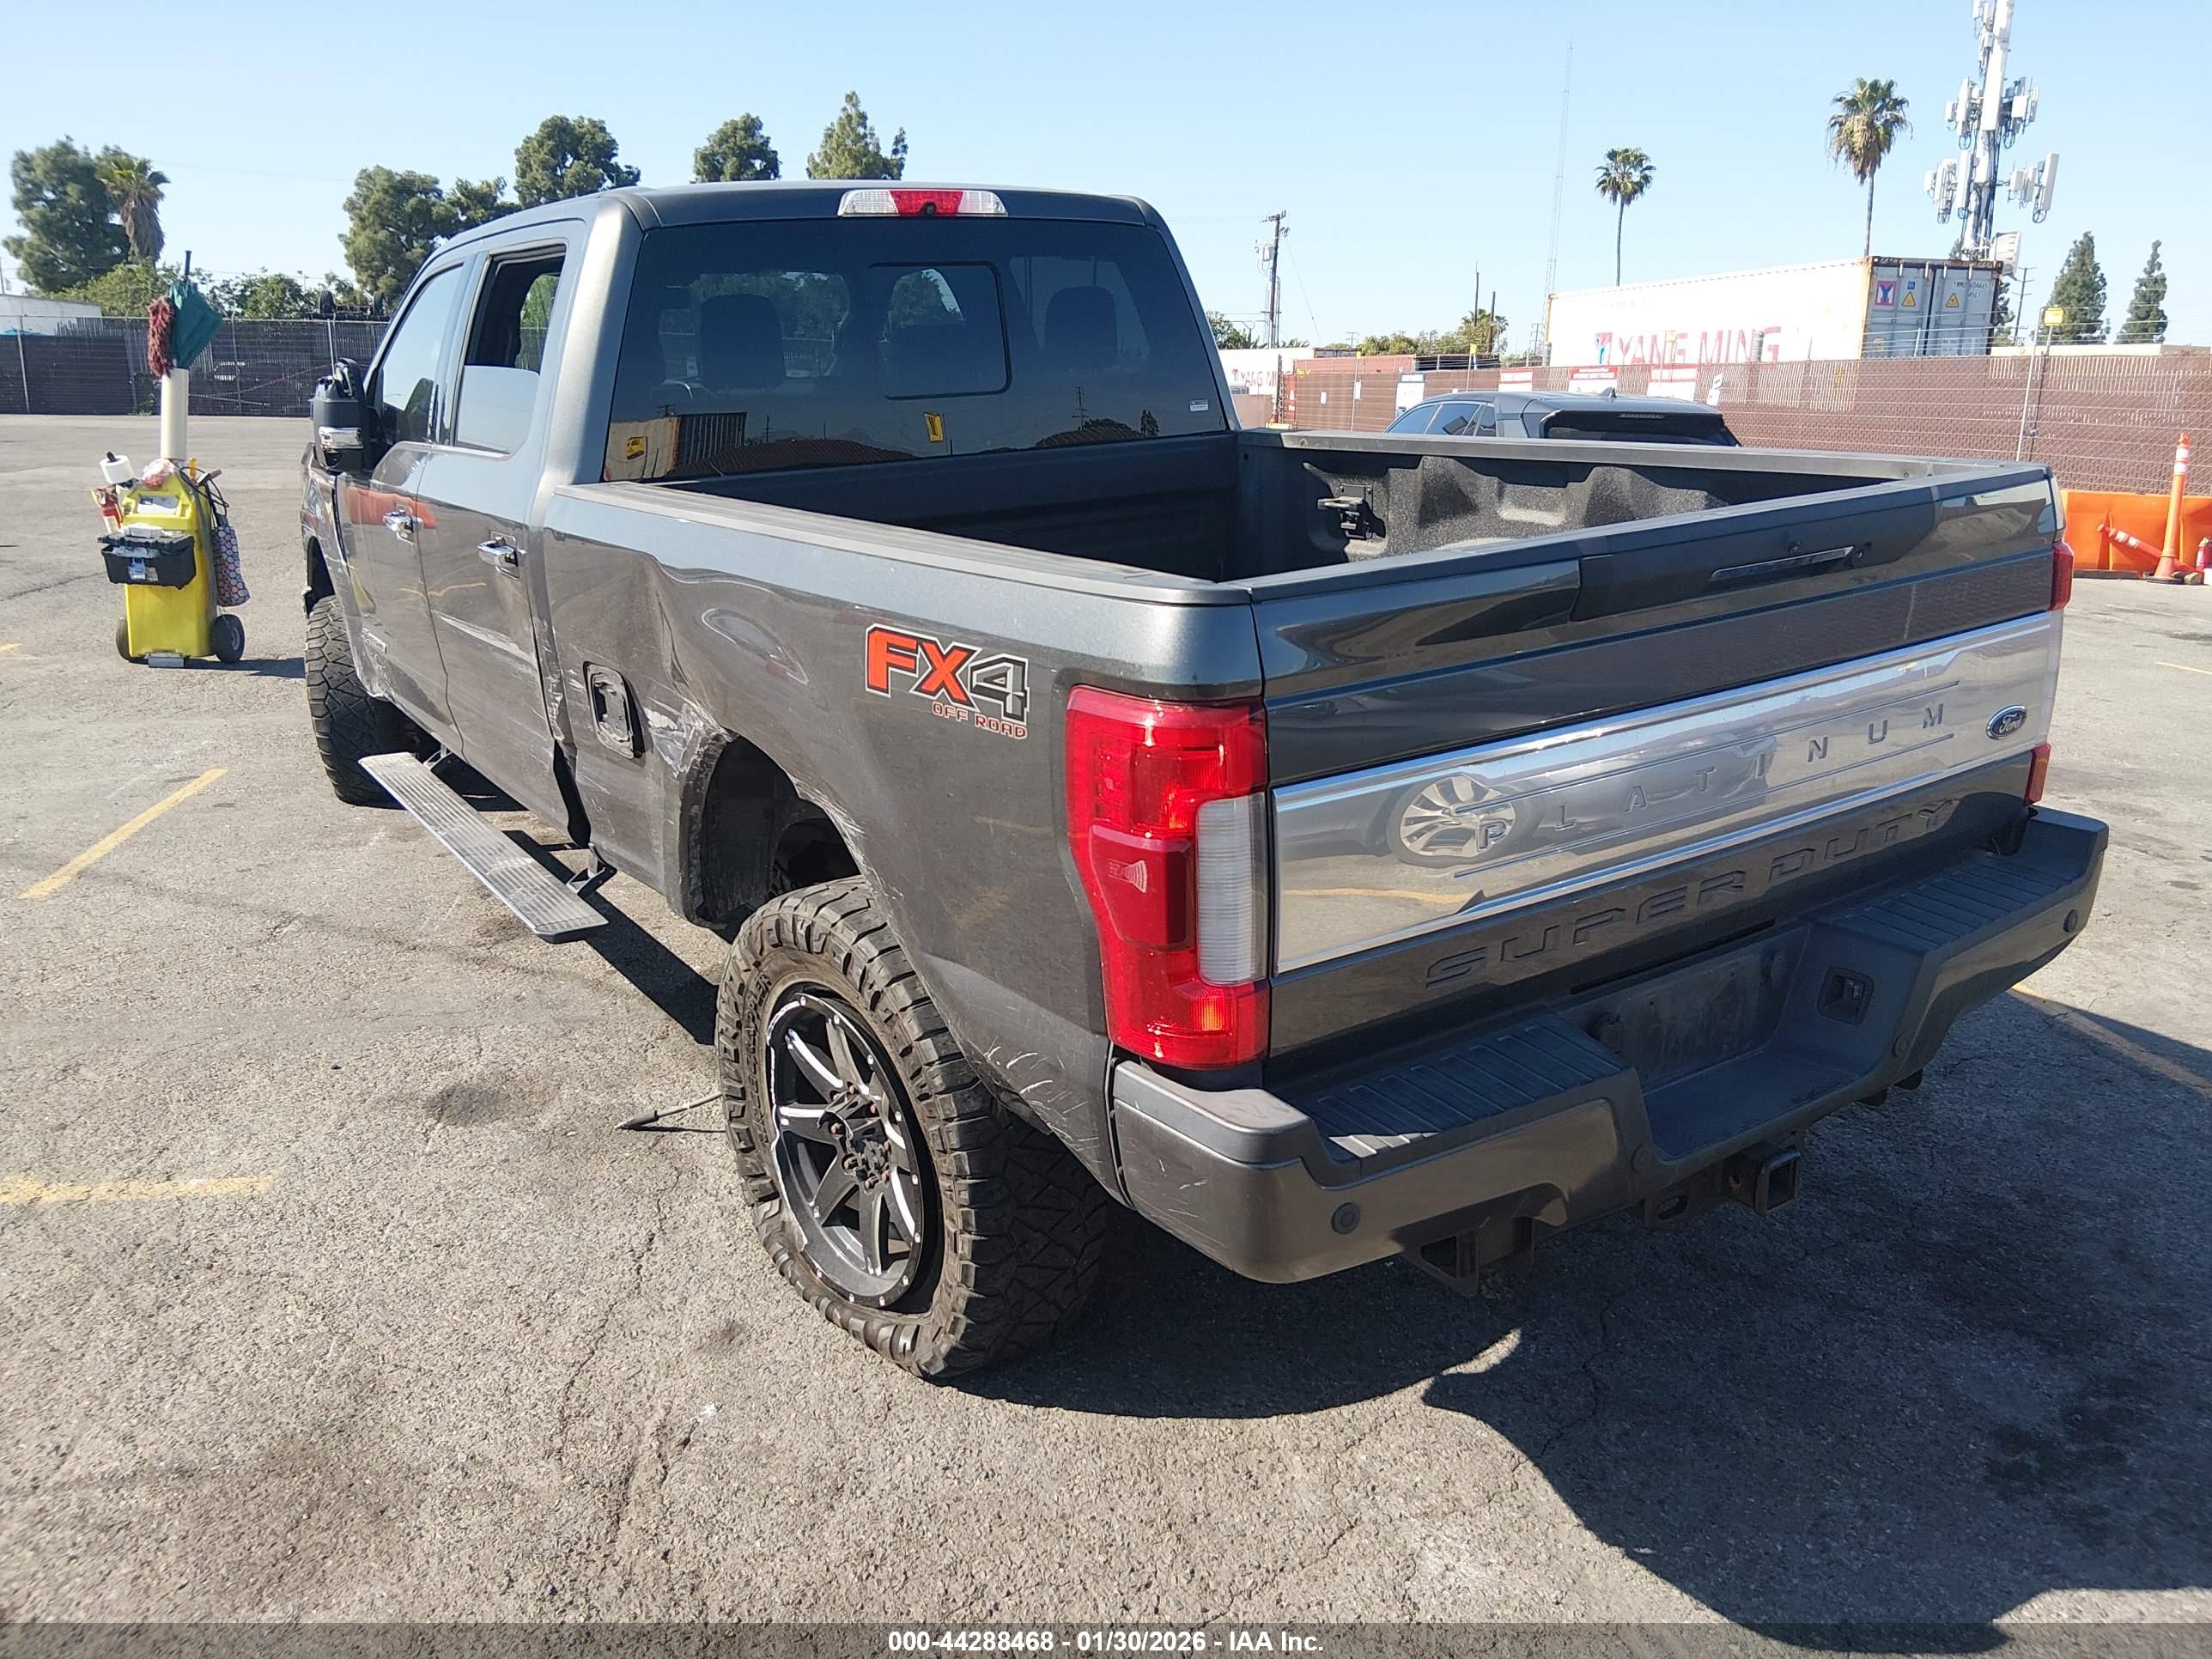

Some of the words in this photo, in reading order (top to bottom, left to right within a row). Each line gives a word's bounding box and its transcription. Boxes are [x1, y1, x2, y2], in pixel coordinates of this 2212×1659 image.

[1618, 332, 1688, 364] YANG
[865, 623, 1030, 726] FX4
[932, 701, 969, 722] OFF
[975, 714, 1028, 740] ROAD
[1477, 702, 1944, 850] PLATINUM
[1425, 868, 1748, 990] SUPER
[1767, 799, 1954, 884] DUTY
